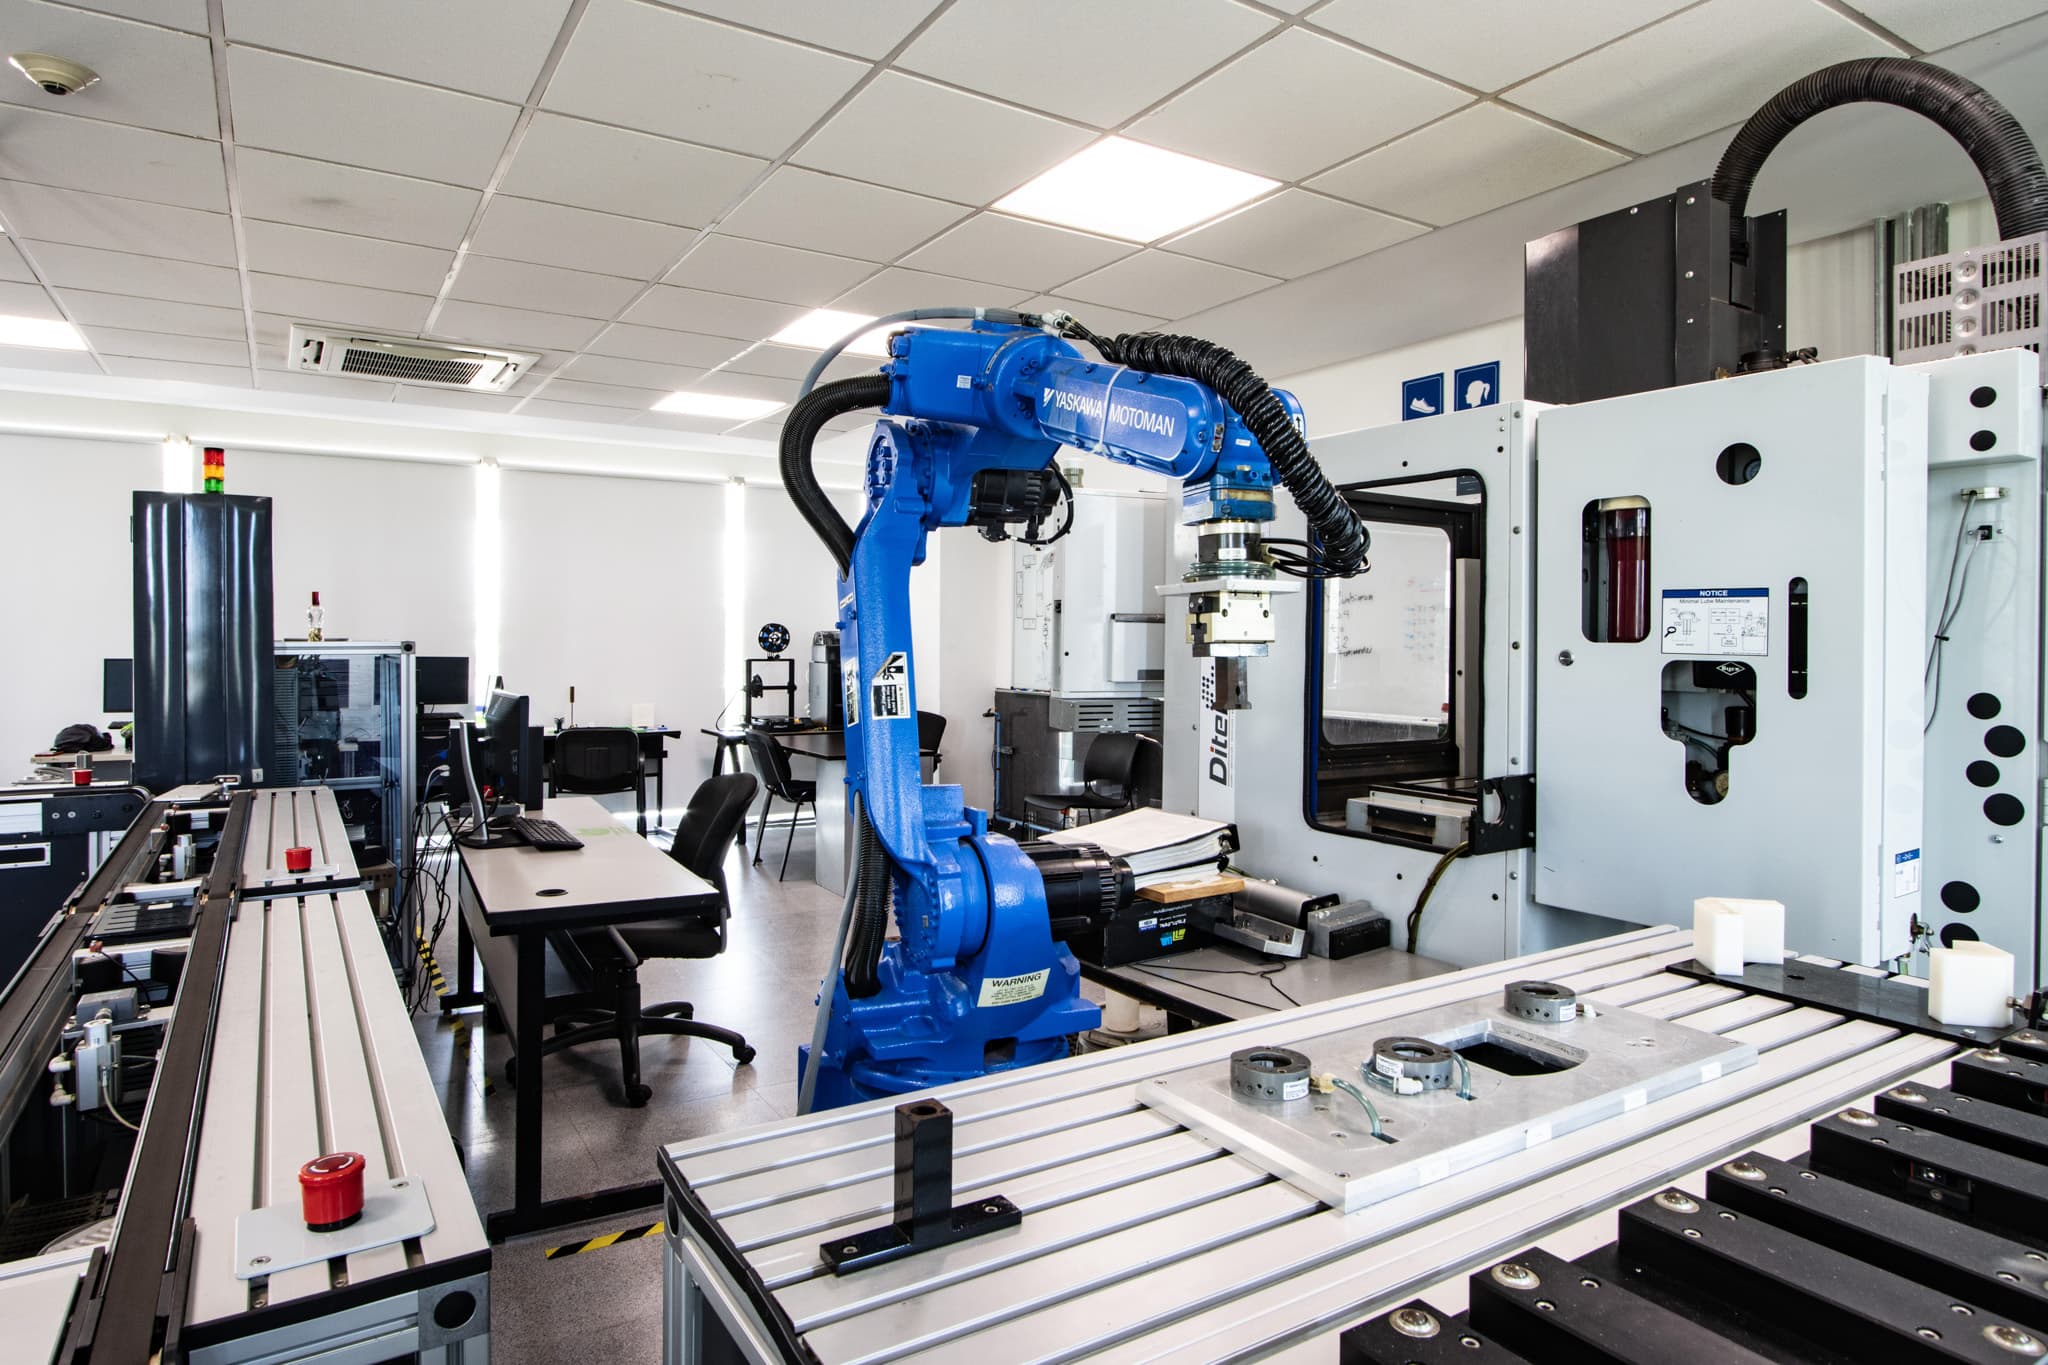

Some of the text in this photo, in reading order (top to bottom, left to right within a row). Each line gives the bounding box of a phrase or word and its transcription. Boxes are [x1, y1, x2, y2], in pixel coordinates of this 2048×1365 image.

[1055, 390, 1175, 437] YASKAWA MOTOMAN
[992, 972, 1042, 987] WARNING
